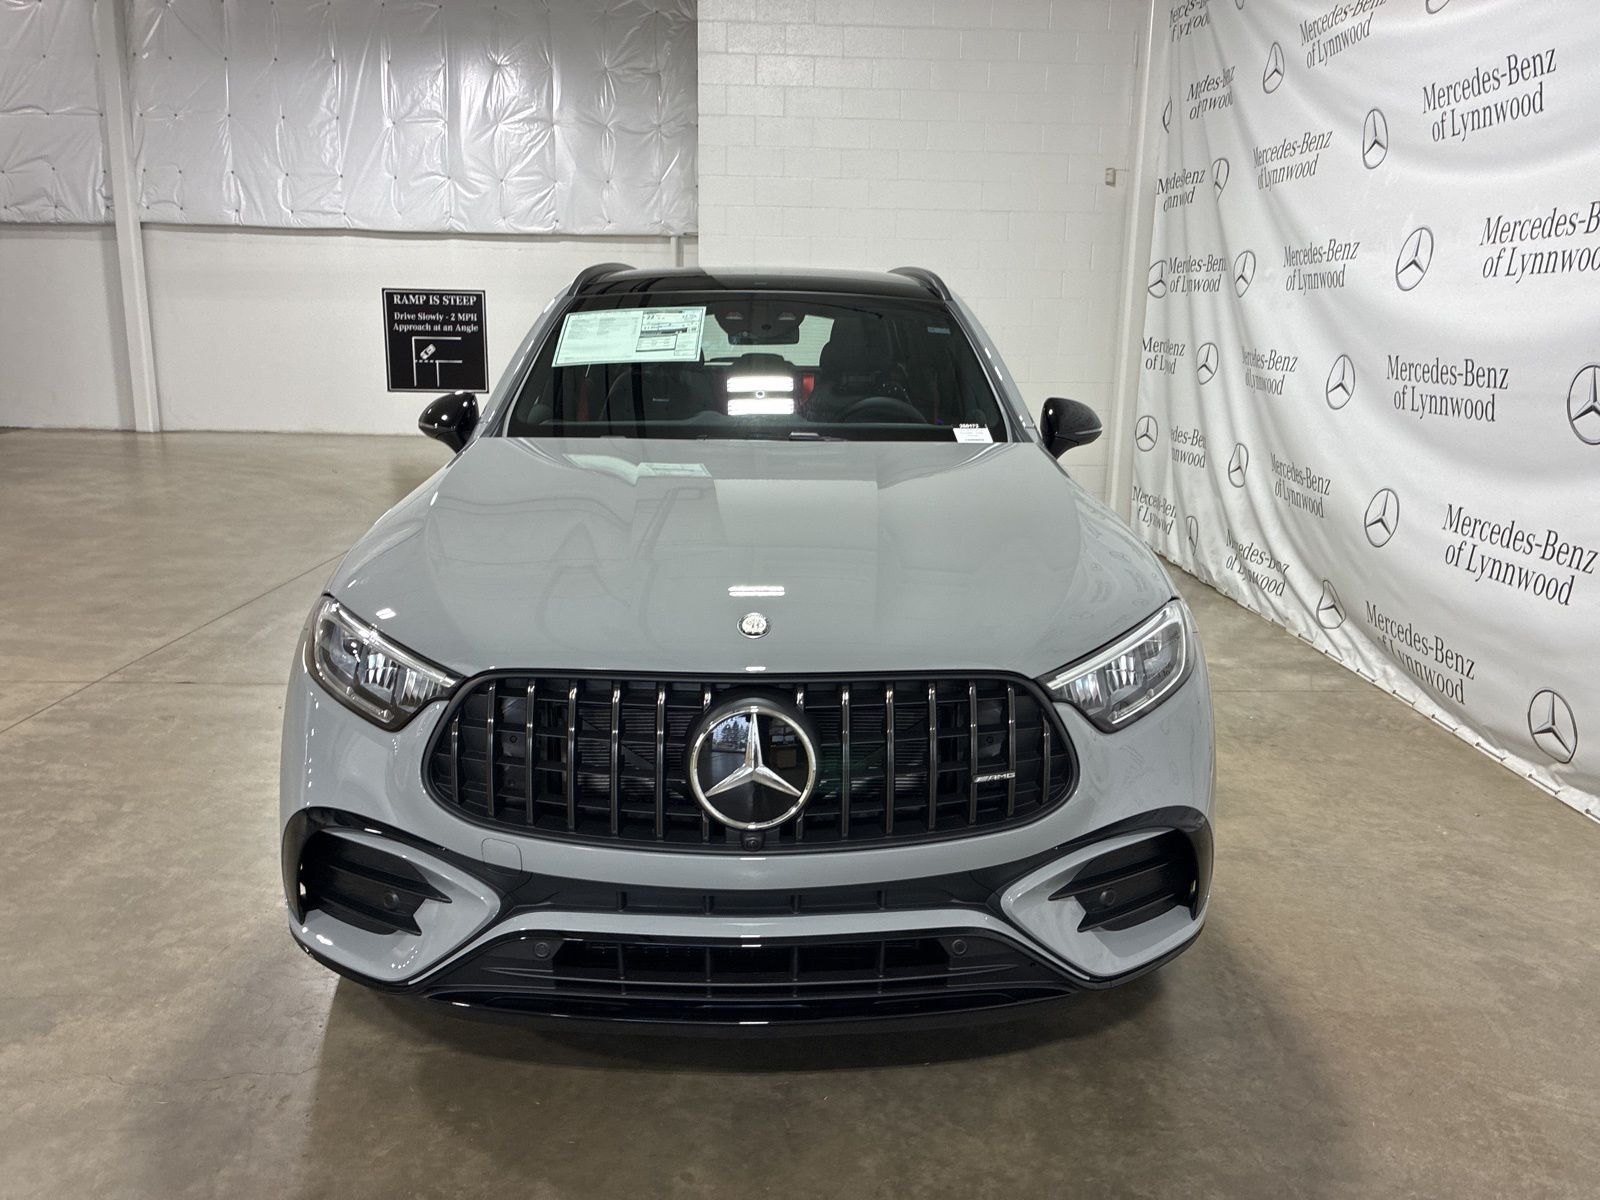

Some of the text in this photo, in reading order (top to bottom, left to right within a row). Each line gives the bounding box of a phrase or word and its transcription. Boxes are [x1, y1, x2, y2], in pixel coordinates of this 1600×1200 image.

[1306, 11, 1374, 69] of Lynnwood
[1422, 48, 1557, 114] Mercedes-Benz
[1432, 81, 1544, 142] of Lynnwood
[1253, 131, 1333, 168] Mercedes-Benz
[1264, 153, 1319, 191] Lynnwood
[1283, 238, 1360, 267] Mercedes-Benz
[1482, 247, 1506, 278] of
[1169, 275, 1181, 293] of
[1286, 264, 1346, 295] of Lynnwood
[393, 294, 477, 306] RAMP IS STEEP
[394, 312, 416, 321] Drive
[417, 312, 443, 322] Slowly
[450, 313, 456, 321] 2
[457, 313, 478, 322] MPH
[393, 322, 431, 332] Approach
[455, 323, 479, 333] Angle
[1145, 354, 1158, 370] of
[1387, 355, 1509, 390] Mercedes-Benz
[1394, 385, 1496, 422] of Lynnwood
[1275, 478, 1324, 518] of Lynnwood
[1442, 503, 1599, 574] Mercedes-Benz
[1445, 540, 1575, 606] of Lynnwood
[1365, 600, 1475, 680] Mercedes-Benz
